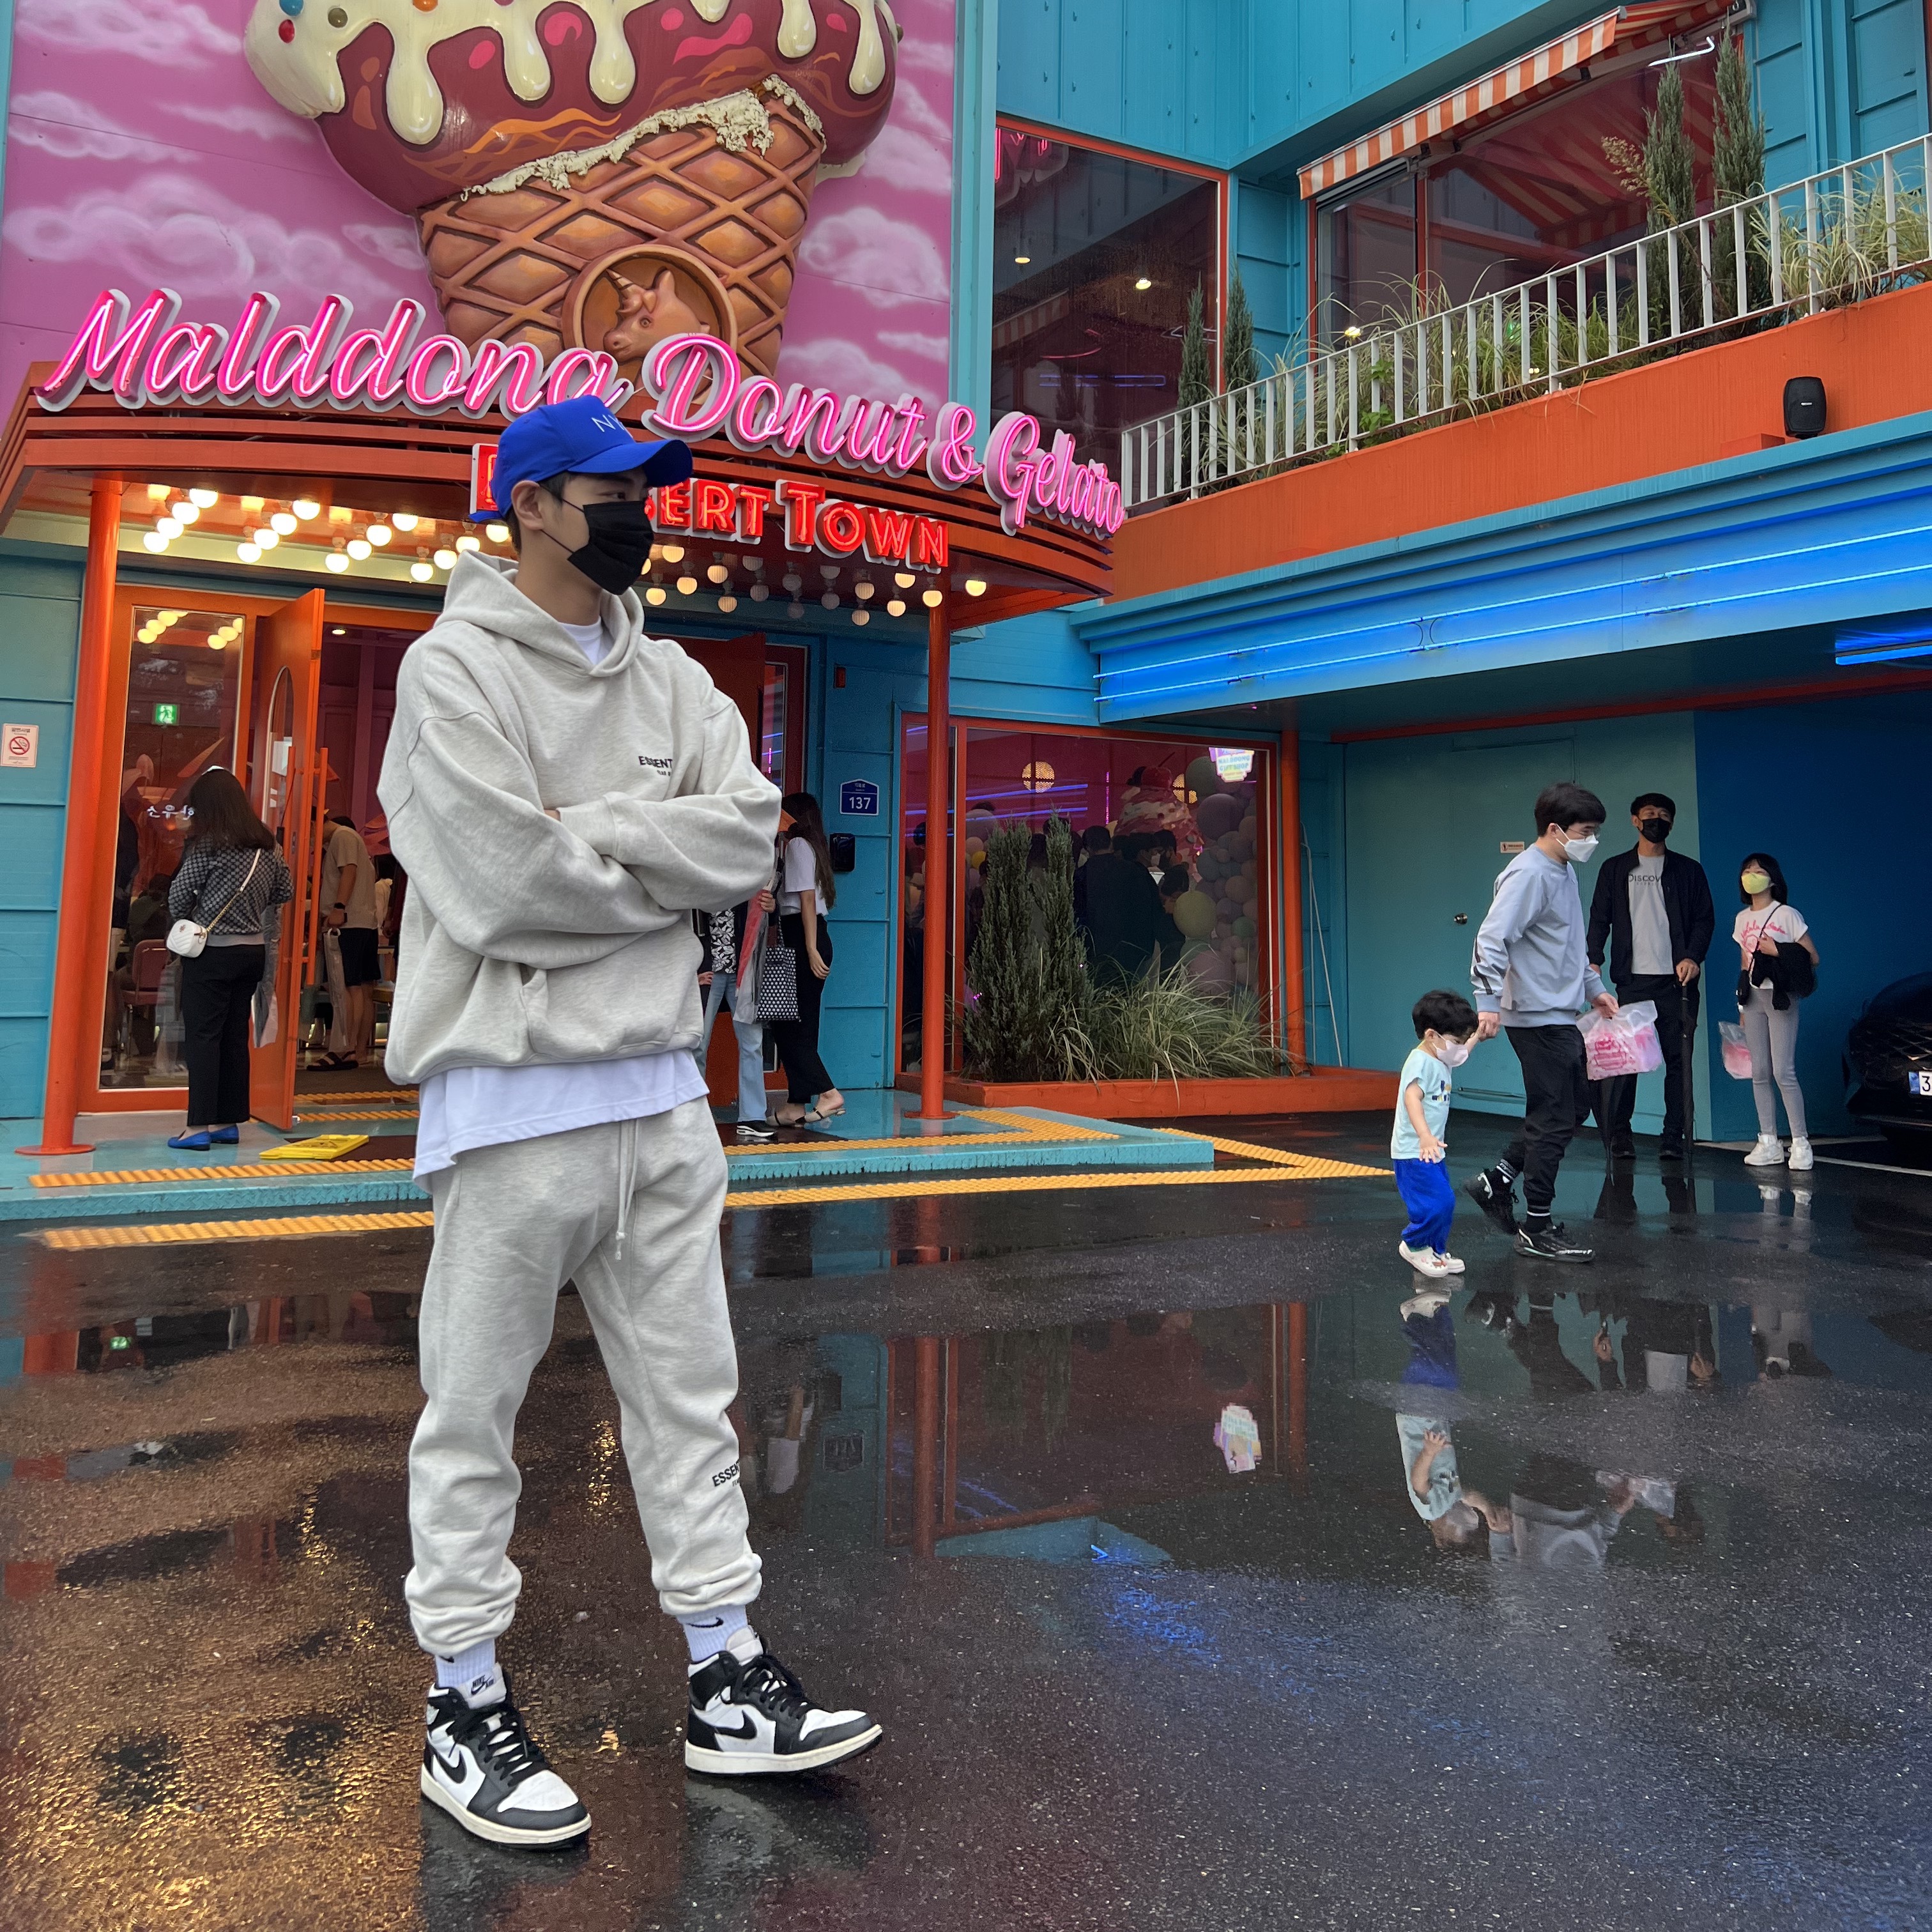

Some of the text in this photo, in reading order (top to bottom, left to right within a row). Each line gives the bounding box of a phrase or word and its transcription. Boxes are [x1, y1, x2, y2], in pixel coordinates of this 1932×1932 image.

[34, 288, 1125, 538] Malddona Donut & Gelato
[777, 480, 949, 571] TOWN
[849, 797, 871, 809] 137
[1922, 1075, 1931, 1092] 3
